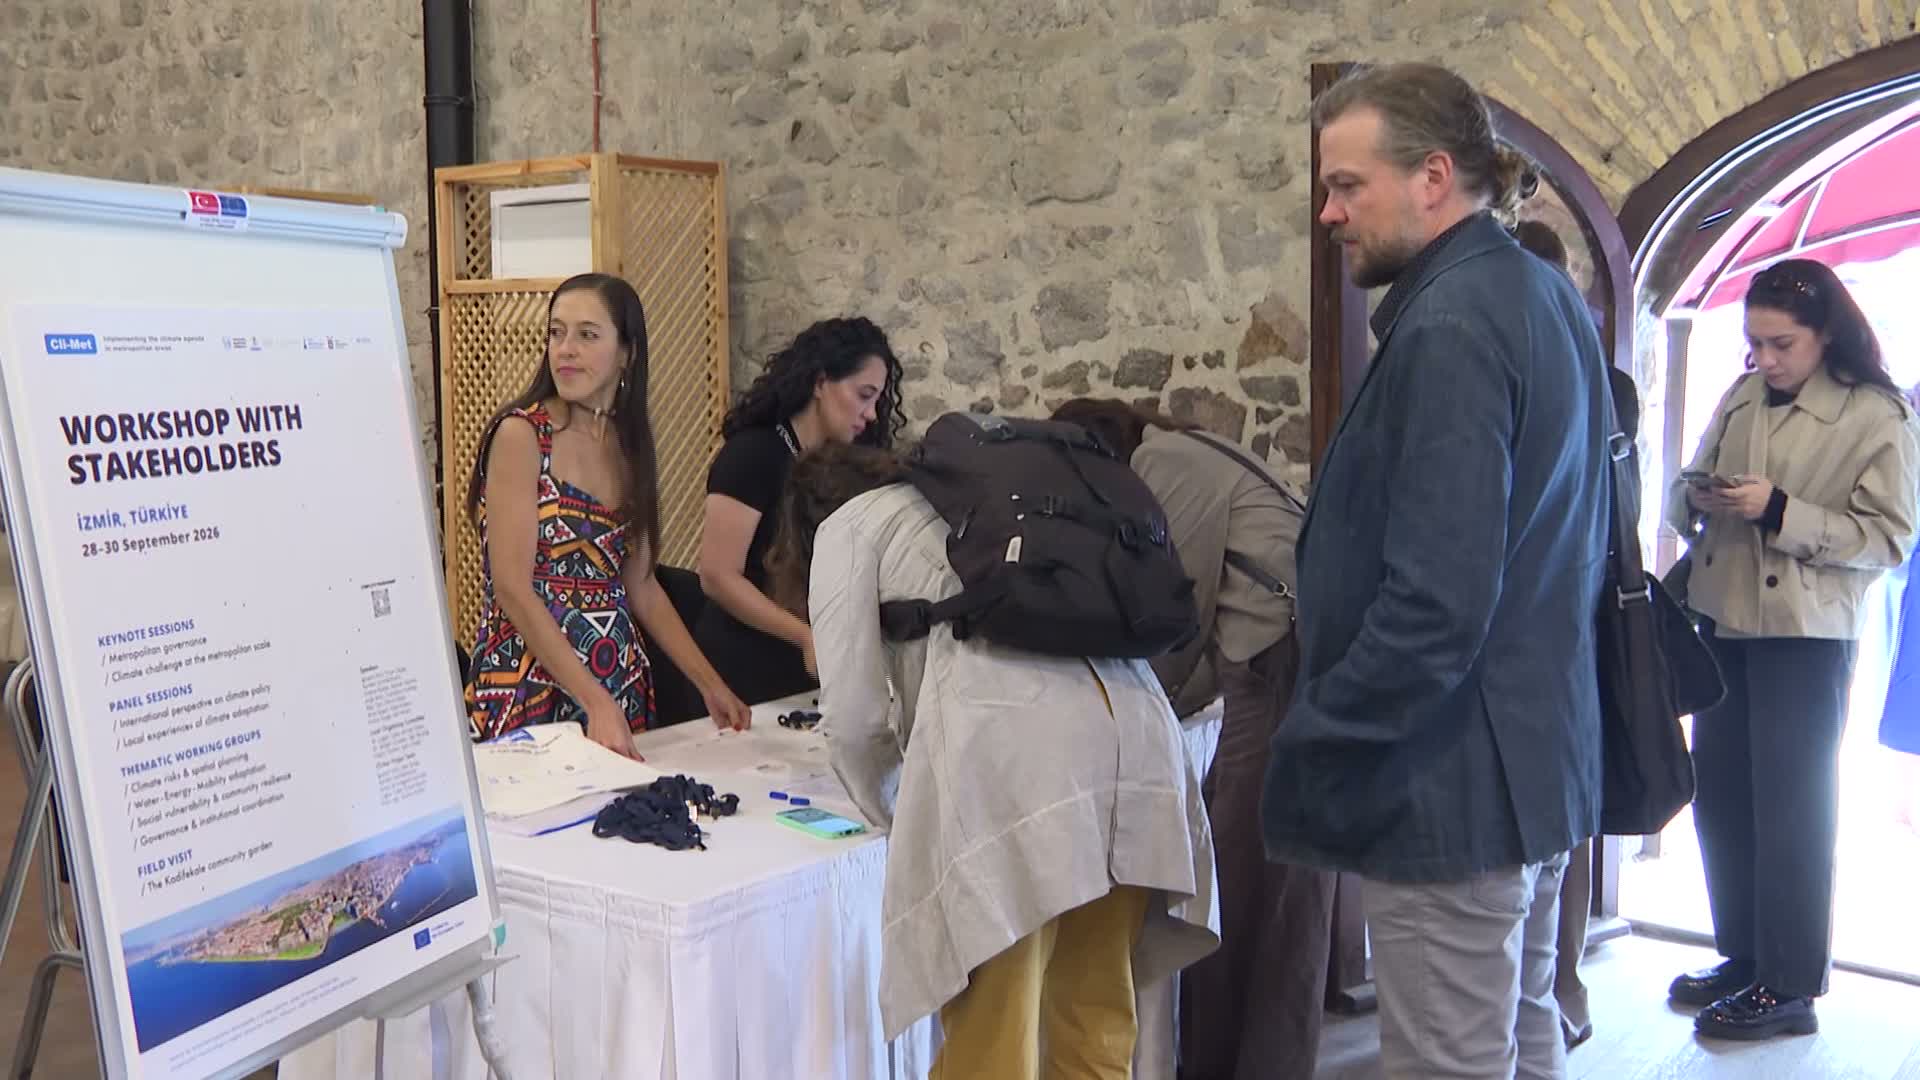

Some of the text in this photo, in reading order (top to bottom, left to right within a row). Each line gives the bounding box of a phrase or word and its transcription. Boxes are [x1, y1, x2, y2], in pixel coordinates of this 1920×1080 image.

[50, 338, 93, 350] Cli-Met
[60, 404, 303, 445] WORKSHOP WITH
[67, 440, 281, 485] STAKEHOLDERS
[76, 502, 189, 531] İZMİR, TÜRKİYE
[82, 526, 220, 557] 28-30 September 2026
[98, 619, 194, 647] KEYNOTE SESSIONS
[108, 646, 161, 664] Metropolitan
[163, 636, 207, 654] governance
[112, 668, 143, 682] Climate
[145, 660, 183, 677] challenge
[184, 656, 193, 666] at
[194, 654, 206, 664] the
[208, 644, 252, 662] metropolitan
[254, 640, 270, 652] scale
[110, 684, 193, 712] PANEL SESSIONS
[120, 707, 169, 728] International
[171, 698, 212, 718] perspective
[214, 696, 224, 705] on
[225, 689, 250, 703] climate
[251, 684, 272, 697] policy
[123, 734, 145, 748] Local
[147, 723, 193, 742] experiences
[195, 717, 203, 728] of
[205, 712, 230, 726] climate
[232, 703, 269, 720] adaptation
[120, 729, 262, 777] THEMATIC WORKING GROUPS
[130, 778, 162, 793] Climate
[164, 772, 181, 783] risks
[183, 768, 190, 778] &
[192, 760, 216, 776] spatial
[218, 752, 249, 769] planning
[228, 764, 266, 782] adaptation
[137, 813, 162, 828] Social
[165, 798, 211, 818] vulnerability
[213, 794, 220, 804] &
[221, 782, 259, 800] community
[260, 772, 292, 788] resilience
[140, 824, 188, 847] Governance
[191, 820, 198, 830] &
[200, 807, 240, 826] institutional
[242, 792, 284, 813] coordination
[138, 849, 193, 878] FIELD VISIT
[148, 880, 162, 893] The
[208, 850, 246, 870] community
[248, 840, 273, 858] garden
